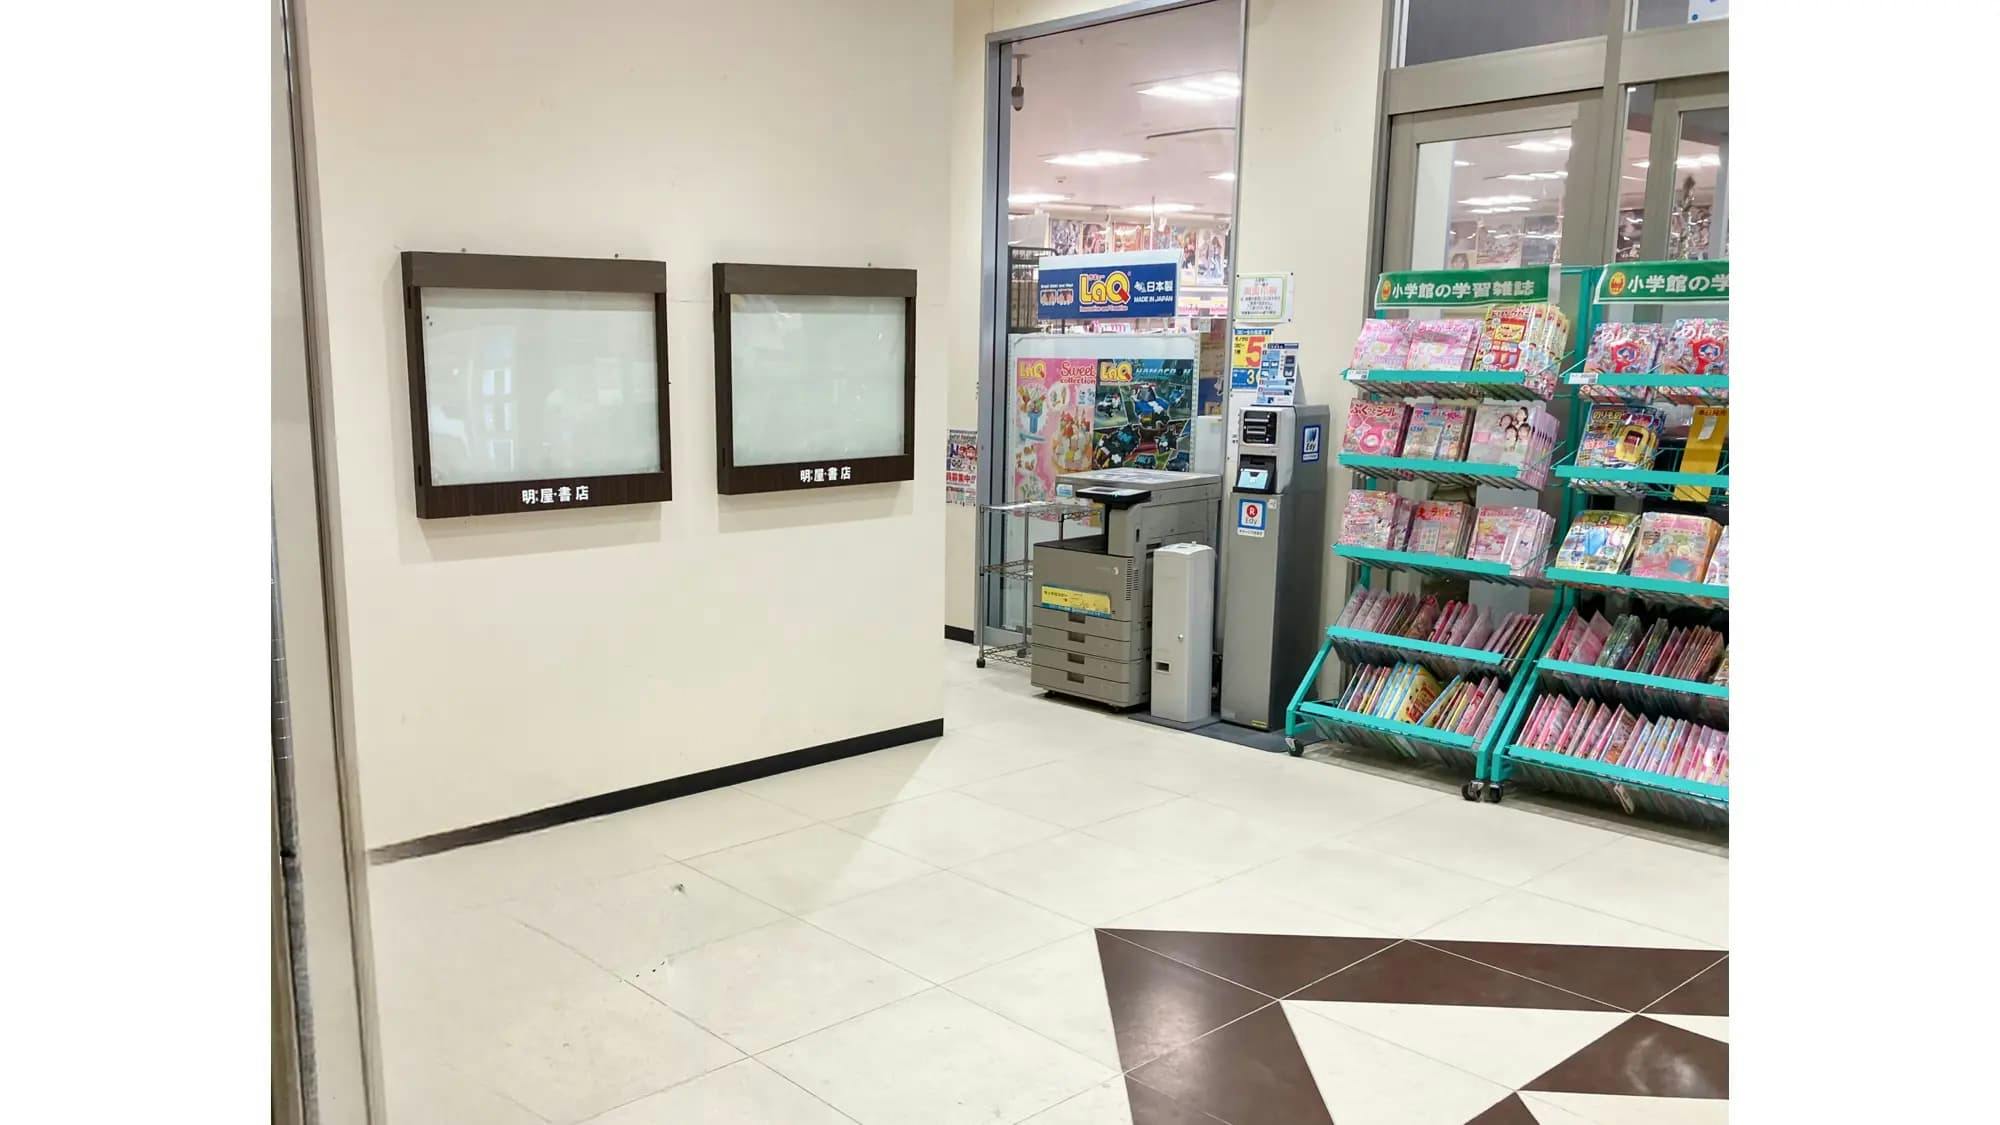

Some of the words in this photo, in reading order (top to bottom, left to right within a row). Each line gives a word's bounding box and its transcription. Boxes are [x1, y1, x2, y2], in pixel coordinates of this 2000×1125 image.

[1080, 271, 1130, 304] LaQ
[1147, 281, 1173, 293] 日本製
[1392, 280, 1535, 299] 小学館の学習雑誌
[1627, 274, 1729, 293] 小学館の学
[1246, 336, 1265, 368] 5
[1060, 361, 1096, 378] Sweet
[1100, 361, 1133, 382] LaQ
